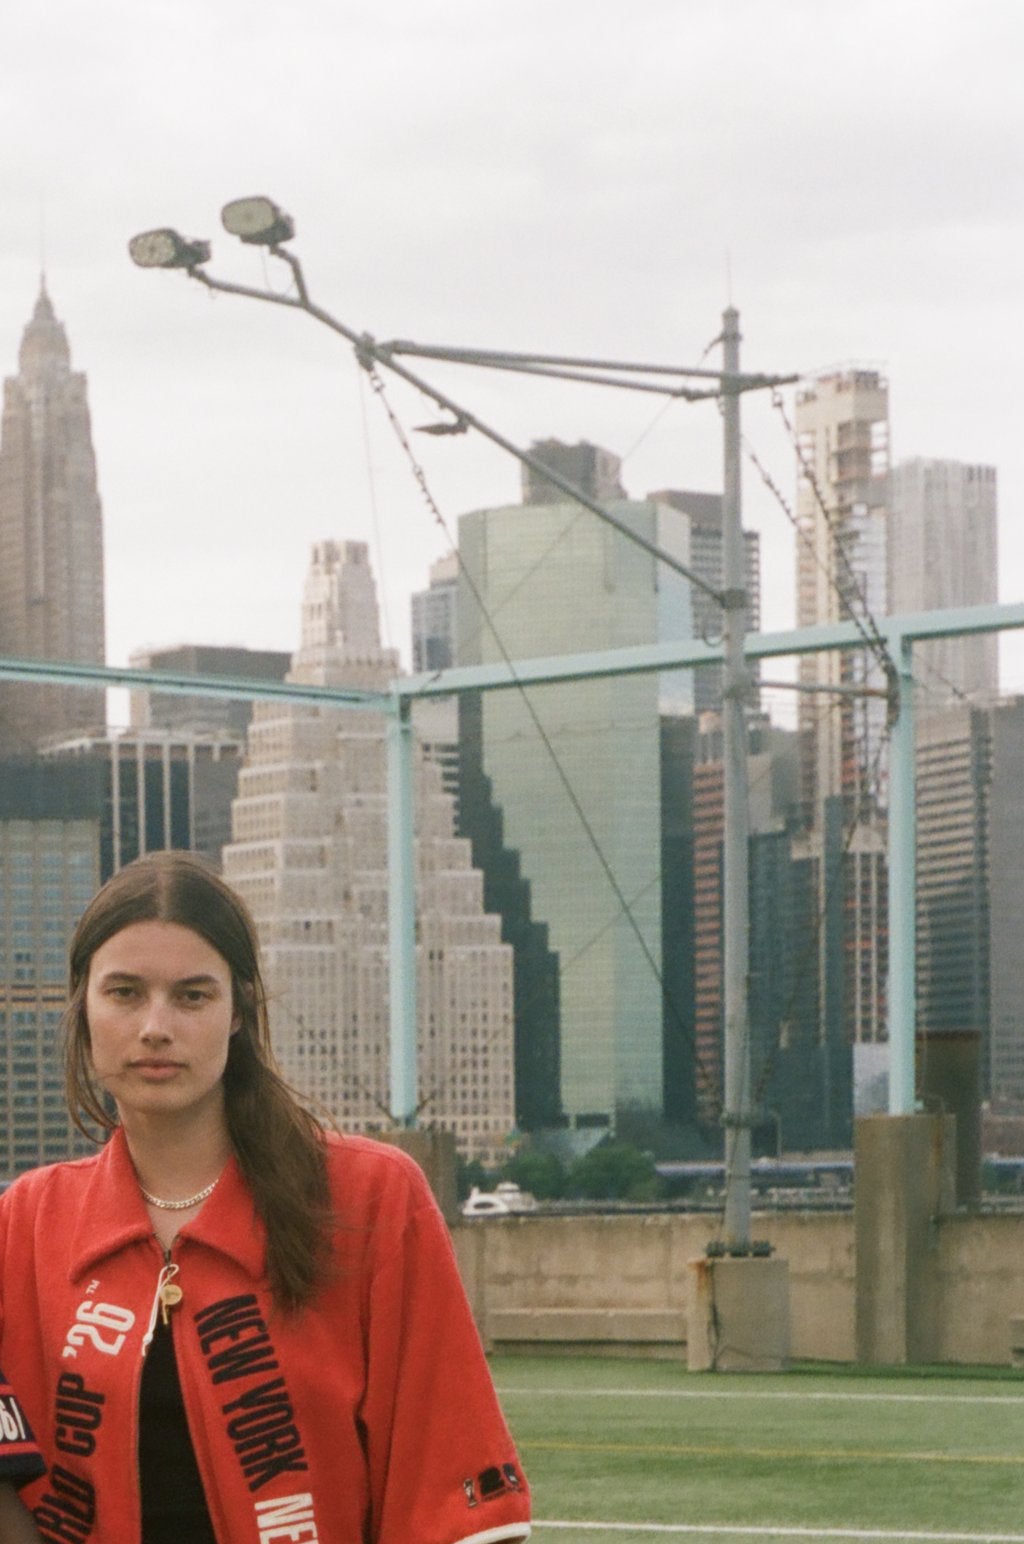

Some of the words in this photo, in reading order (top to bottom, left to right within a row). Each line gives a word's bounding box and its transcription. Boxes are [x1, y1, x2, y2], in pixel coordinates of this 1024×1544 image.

[194, 1294, 280, 1385] NEW
[54, 1371, 106, 1458] CUP
[222, 1377, 308, 1492] YORK
